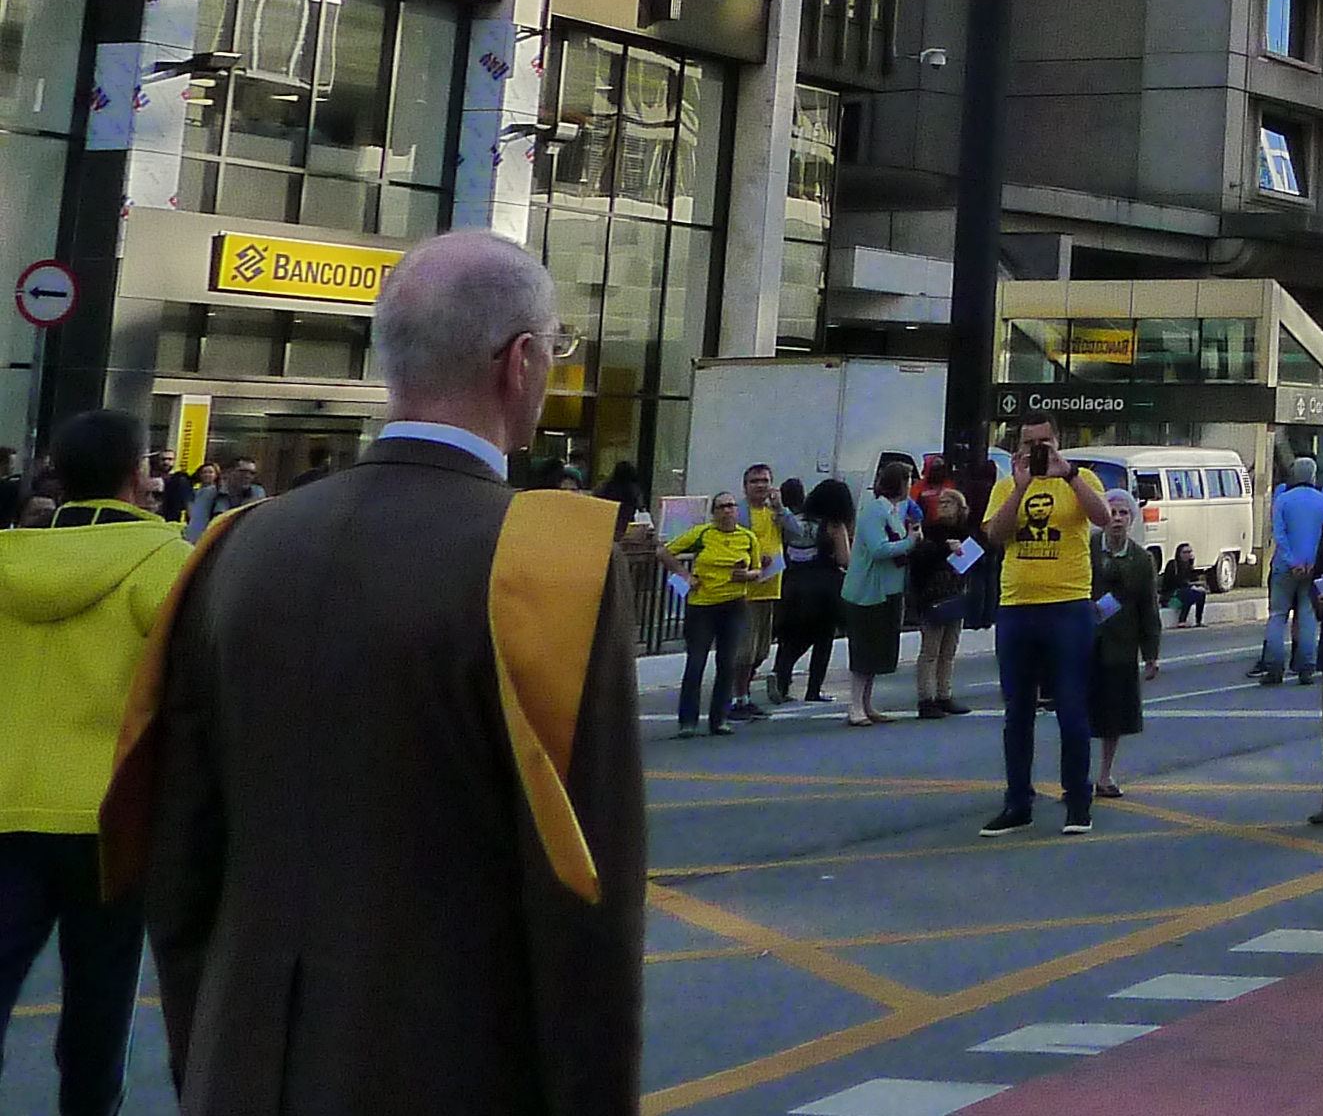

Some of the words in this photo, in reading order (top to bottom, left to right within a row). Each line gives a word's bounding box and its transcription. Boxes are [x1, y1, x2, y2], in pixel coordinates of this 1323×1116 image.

[272, 253, 346, 286] BANCO
[349, 266, 376, 289] DO
[1029, 394, 1124, 414] Consolação
